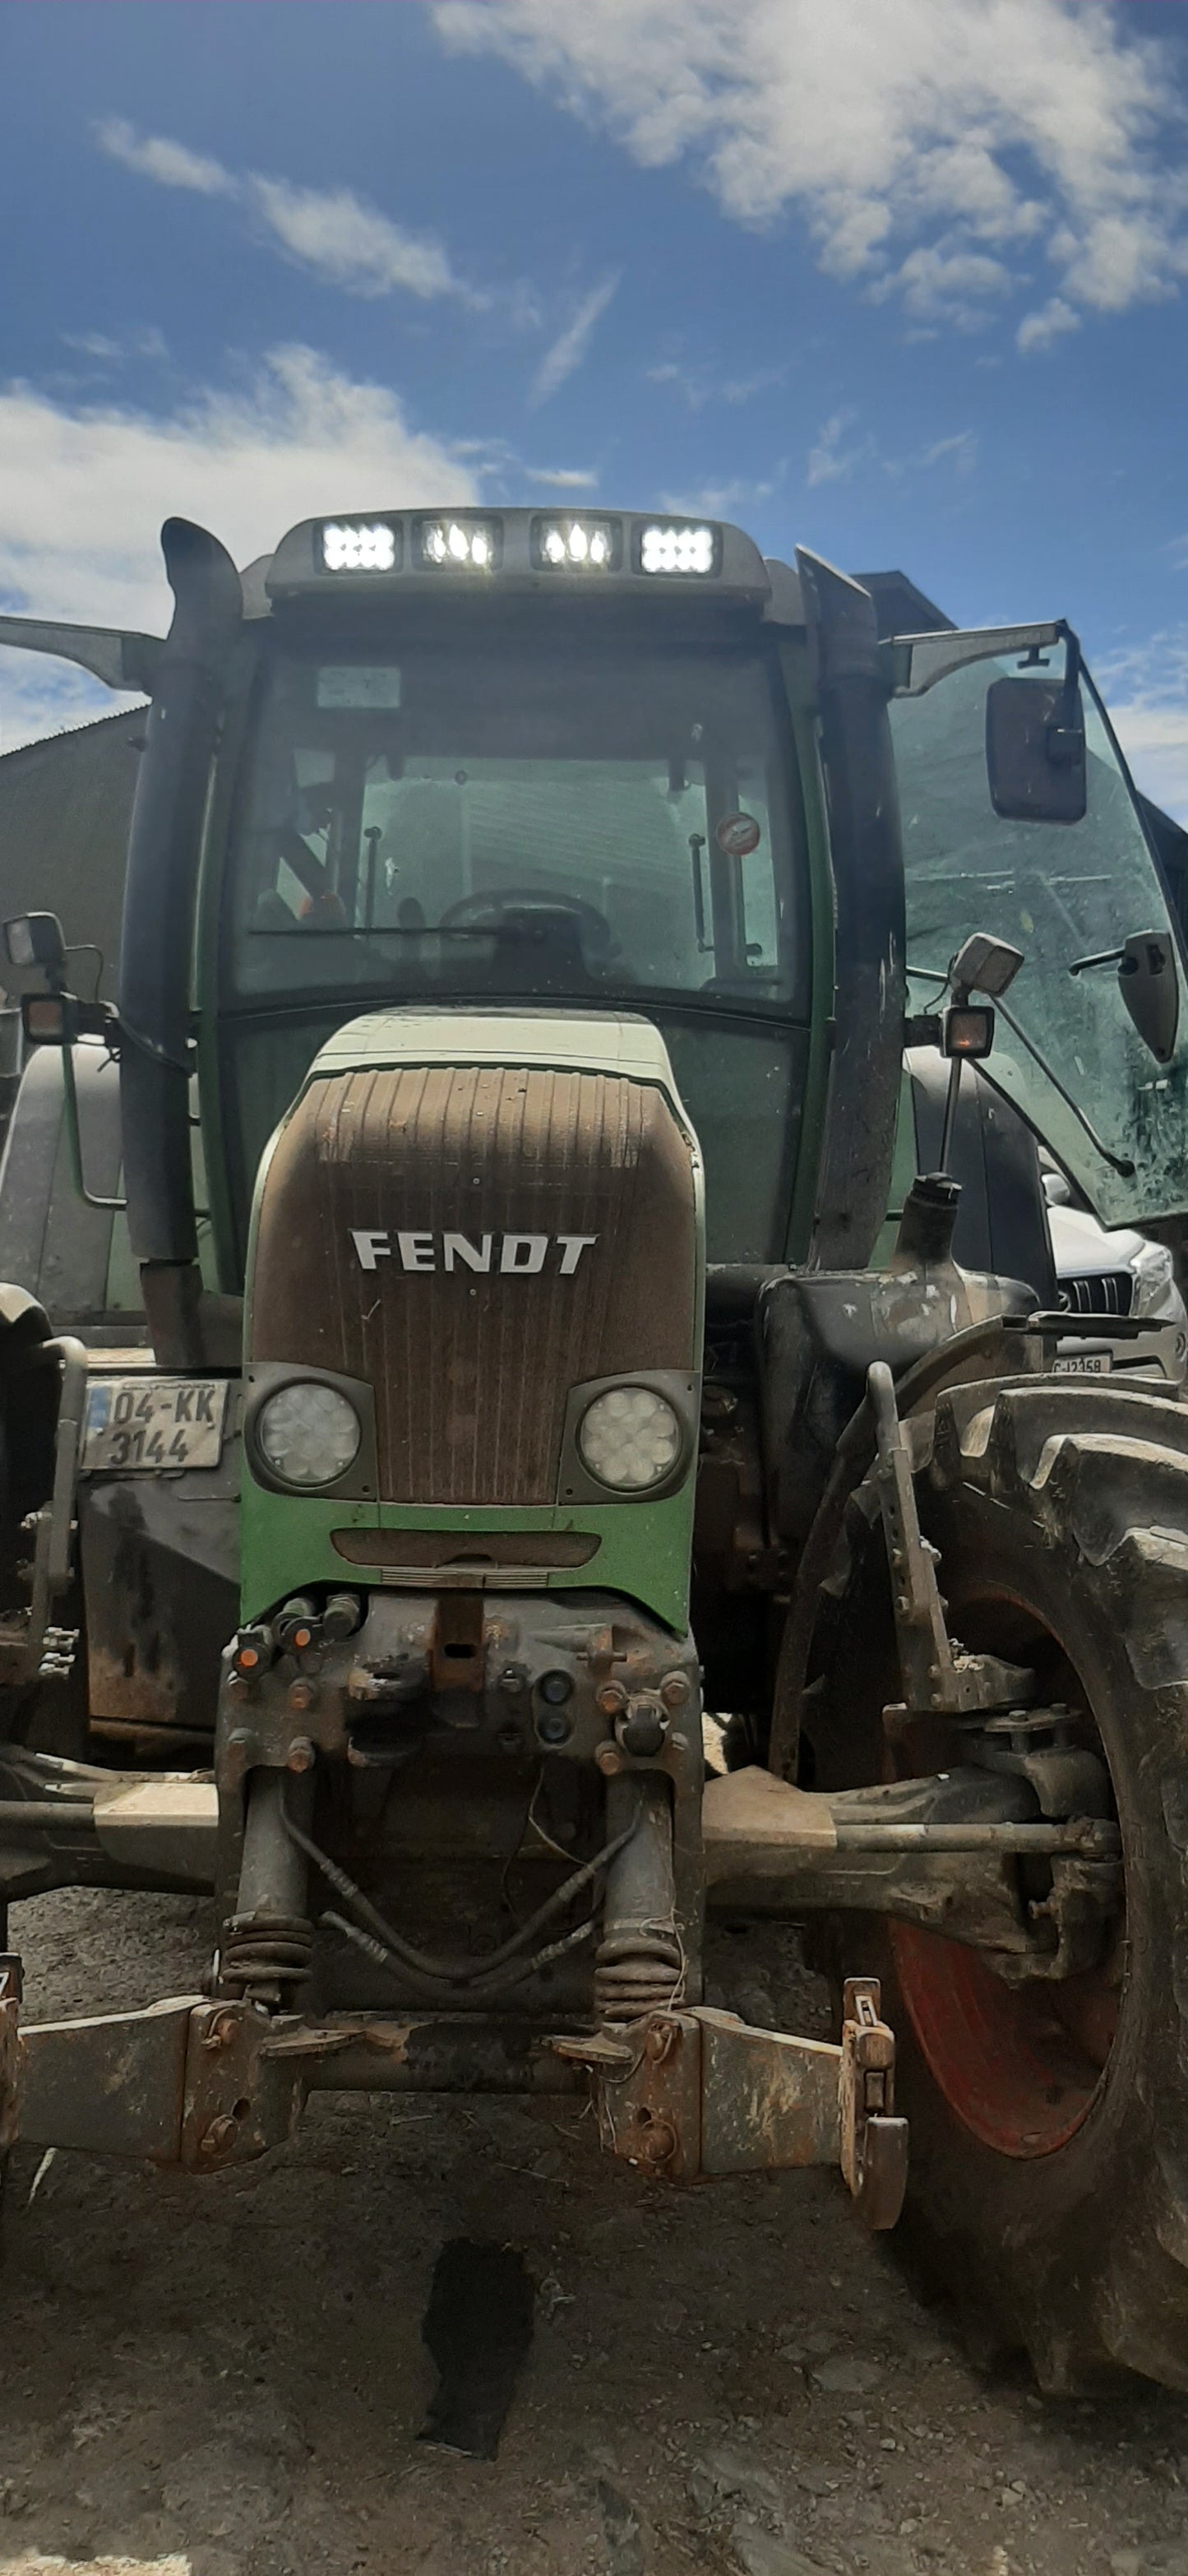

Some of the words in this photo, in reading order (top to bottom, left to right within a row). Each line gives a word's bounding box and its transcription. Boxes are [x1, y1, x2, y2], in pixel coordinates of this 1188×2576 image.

[348, 1228, 599, 1274] FENDT
[113, 1390, 215, 1424] 04-KK
[110, 1429, 188, 1464] 3144
